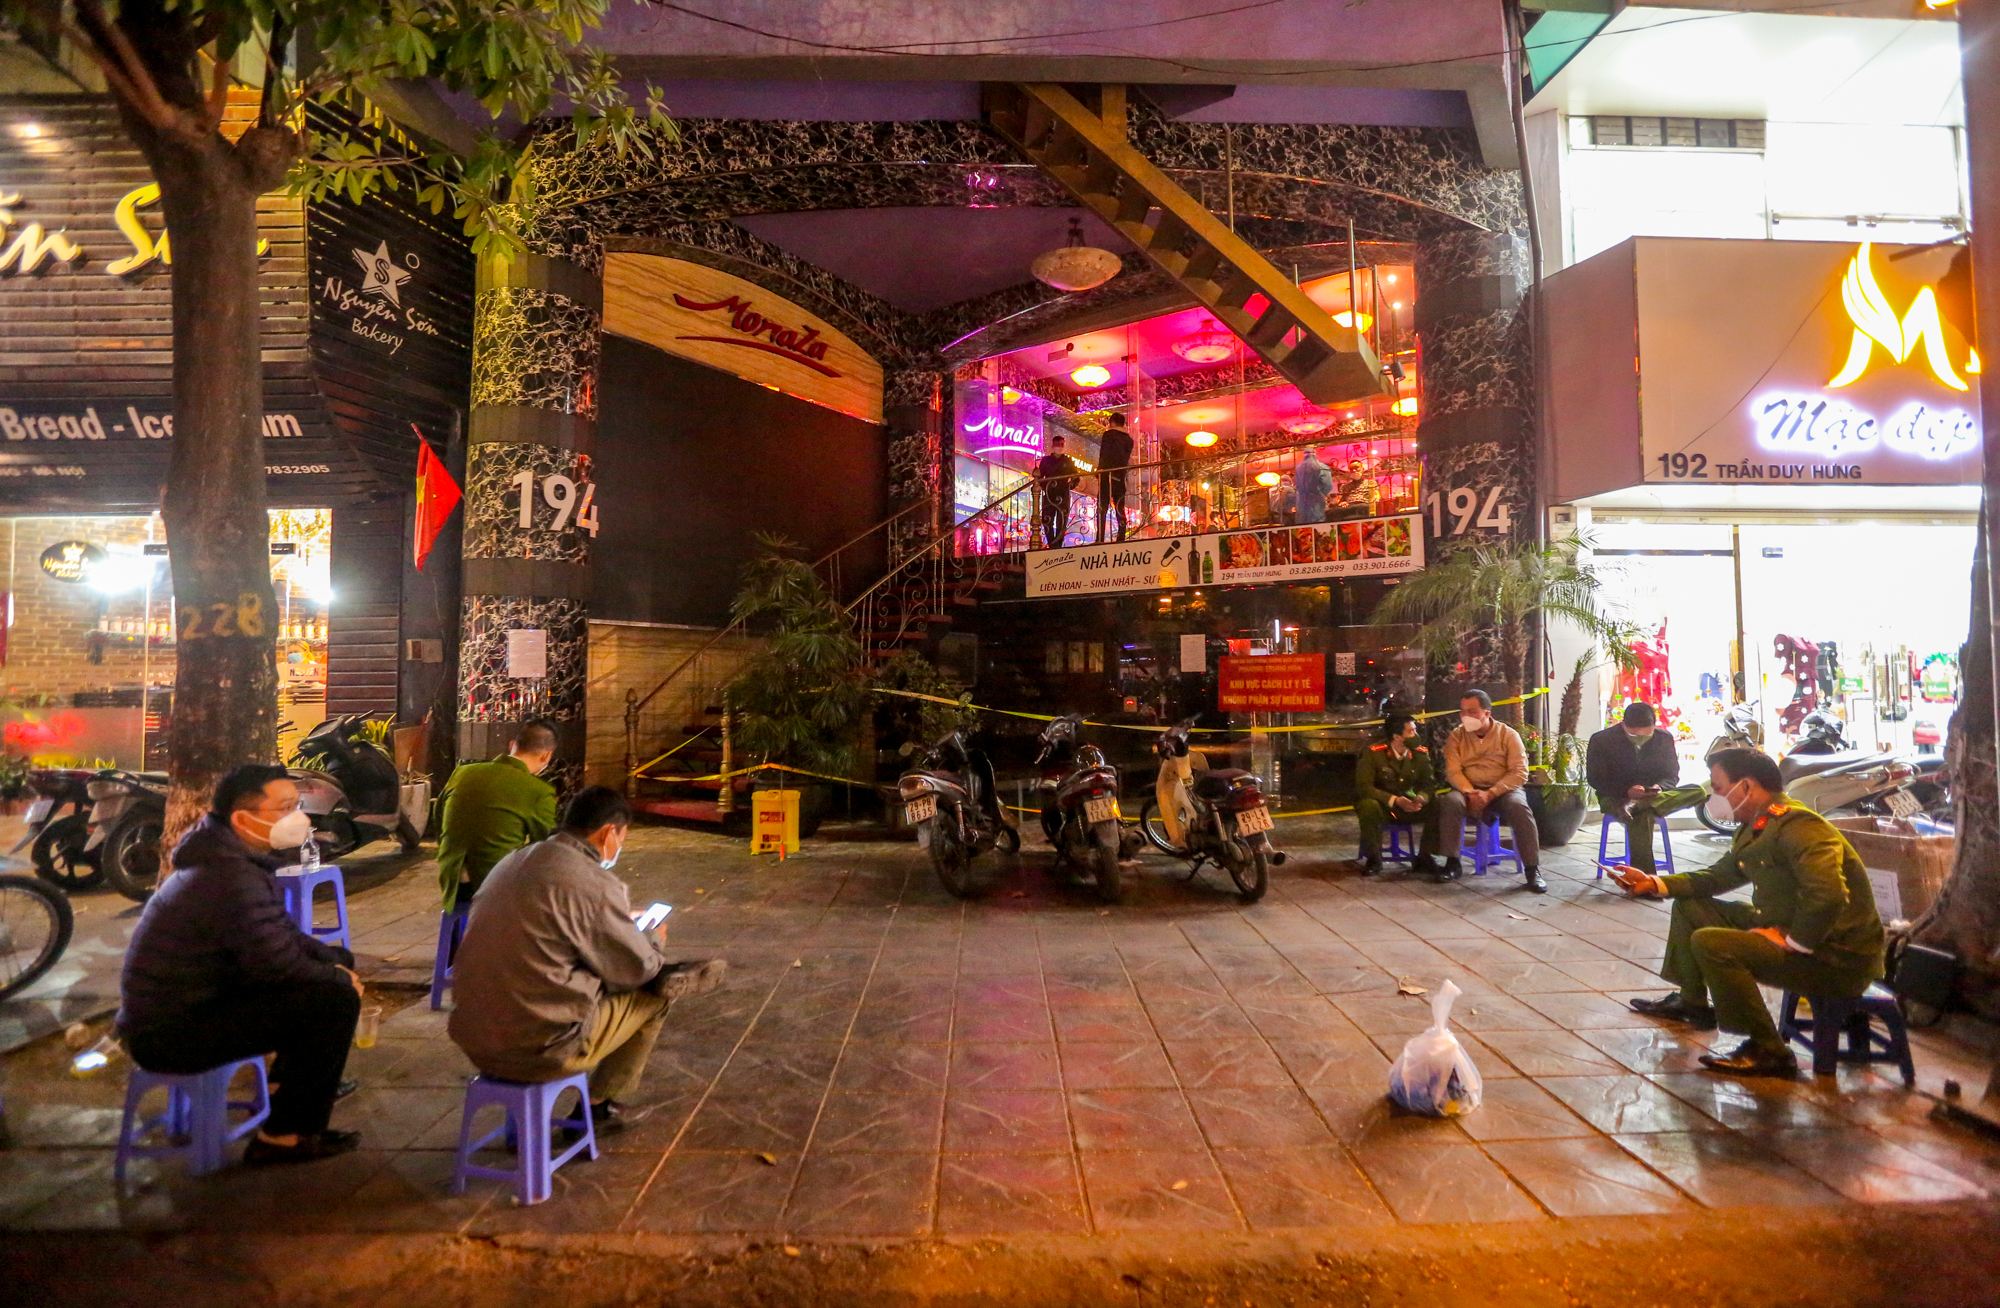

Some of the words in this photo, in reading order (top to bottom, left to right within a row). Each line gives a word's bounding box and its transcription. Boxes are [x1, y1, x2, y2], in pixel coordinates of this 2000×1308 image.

[323, 277, 397, 321] Nguyễn
[405, 307, 439, 336] Sơn
[351, 317, 404, 356] Bakery
[0, 405, 107, 440] Bread
[1658, 452, 1708, 479] 192
[1715, 458, 1764, 479] TRẦN
[1769, 464, 1805, 479] DUY
[1811, 463, 1862, 480] HƯNG
[512, 471, 600, 538] 194
[1427, 485, 1512, 538] 194
[1079, 551, 1109, 571] NHÀ
[1112, 548, 1153, 569] HÀNG
[1221, 571, 1236, 581] 194
[1252, 570, 1265, 578] DUY
[1289, 563, 1345, 576] 03.8286.9999
[1352, 559, 1411, 571] 033.901.6666
[1039, 581, 1058, 592] LIÊN
[1058, 580, 1082, 591] HOAN
[1089, 577, 1111, 588] SINH
[1111, 575, 1136, 589] NHẬT
[1143, 575, 1157, 586] SỰ
[1230, 680, 1244, 689] KHU
[910, 806, 933, 822] 8635
